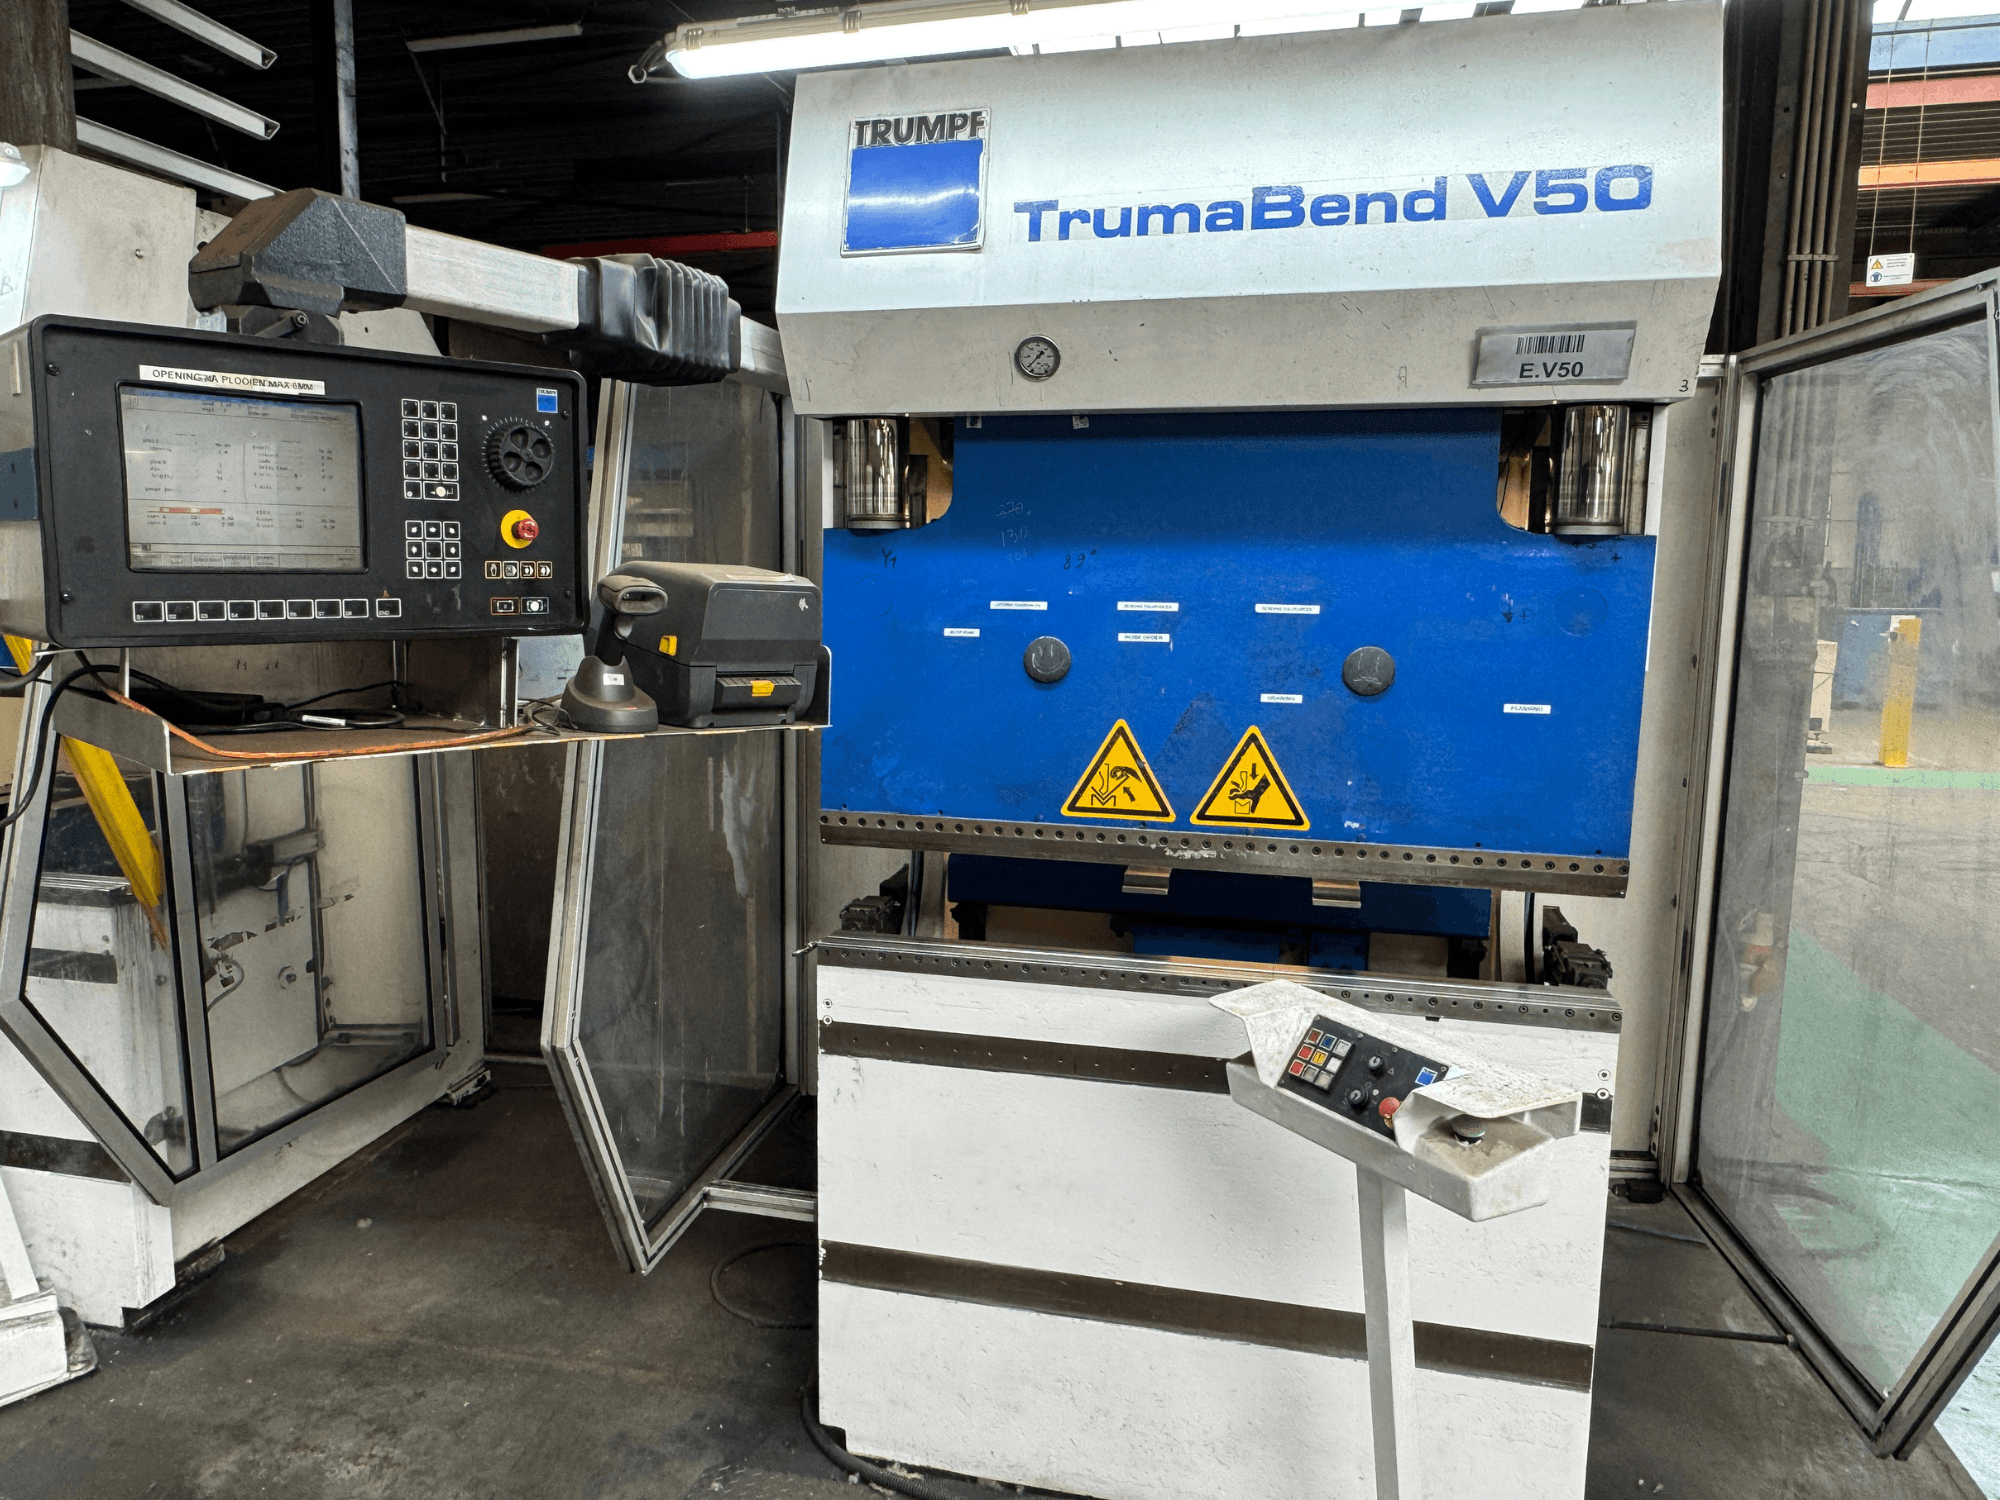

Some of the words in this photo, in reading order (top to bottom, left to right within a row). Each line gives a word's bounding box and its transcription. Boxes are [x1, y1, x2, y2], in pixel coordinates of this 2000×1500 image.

[854, 110, 986, 147] TRUMPF
[1013, 175, 1447, 242] TrumaBend
[1466, 164, 1653, 218] V50
[152, 369, 200, 382] OPENING
[221, 375, 266, 387] PLOOIEN
[268, 380, 290, 389] MAX
[1518, 361, 1584, 379] E.V50
[1678, 379, 1690, 393] 3
